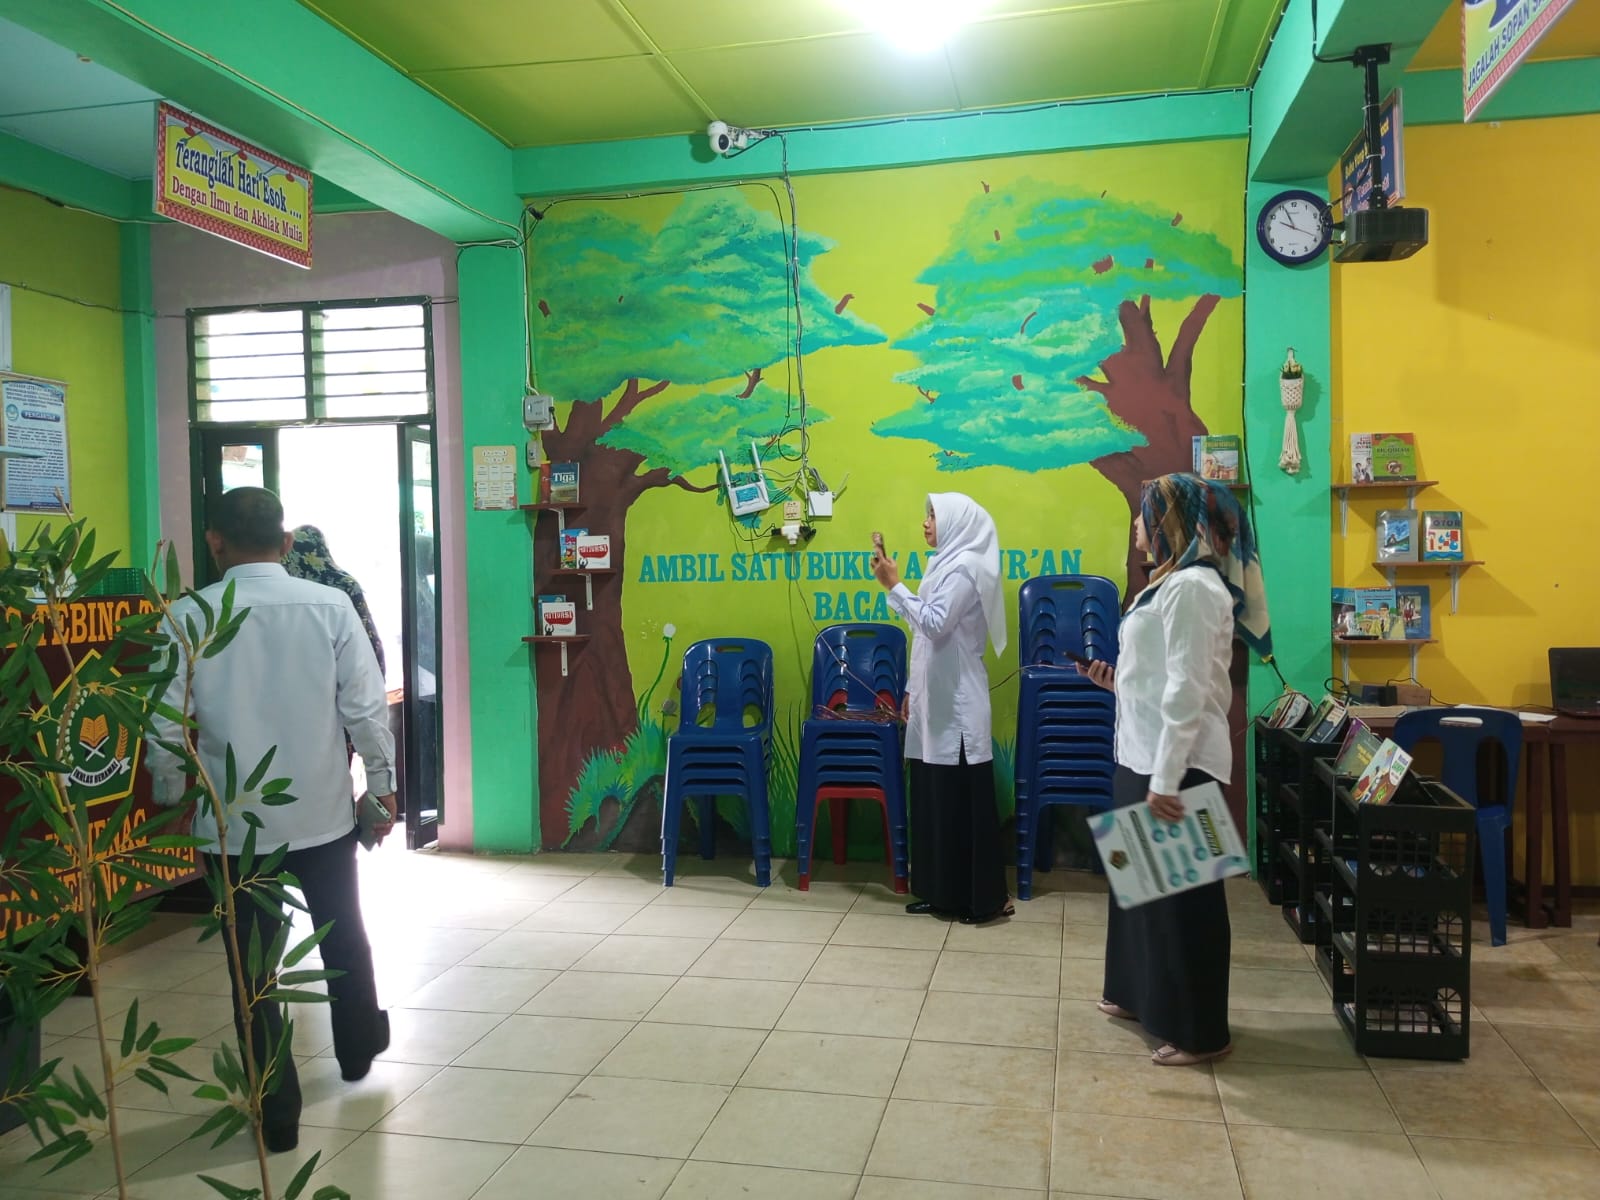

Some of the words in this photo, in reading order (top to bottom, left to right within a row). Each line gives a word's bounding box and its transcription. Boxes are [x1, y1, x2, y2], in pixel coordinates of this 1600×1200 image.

[1467, 35, 1500, 92] JAGALAH
[1501, 3, 1530, 50] SOPAN
[172, 175, 207, 206] Dengan
[210, 189, 231, 215] Ilmu
[233, 199, 249, 222] dan
[251, 207, 280, 235] Akhlak
[282, 218, 303, 243] Mulia
[176, 140, 235, 189] Terangilah
[238, 159, 260, 200] Hari
[262, 174, 287, 214] Esok
[638, 553, 725, 582] AMBIL
[731, 552, 800, 581] SATU
